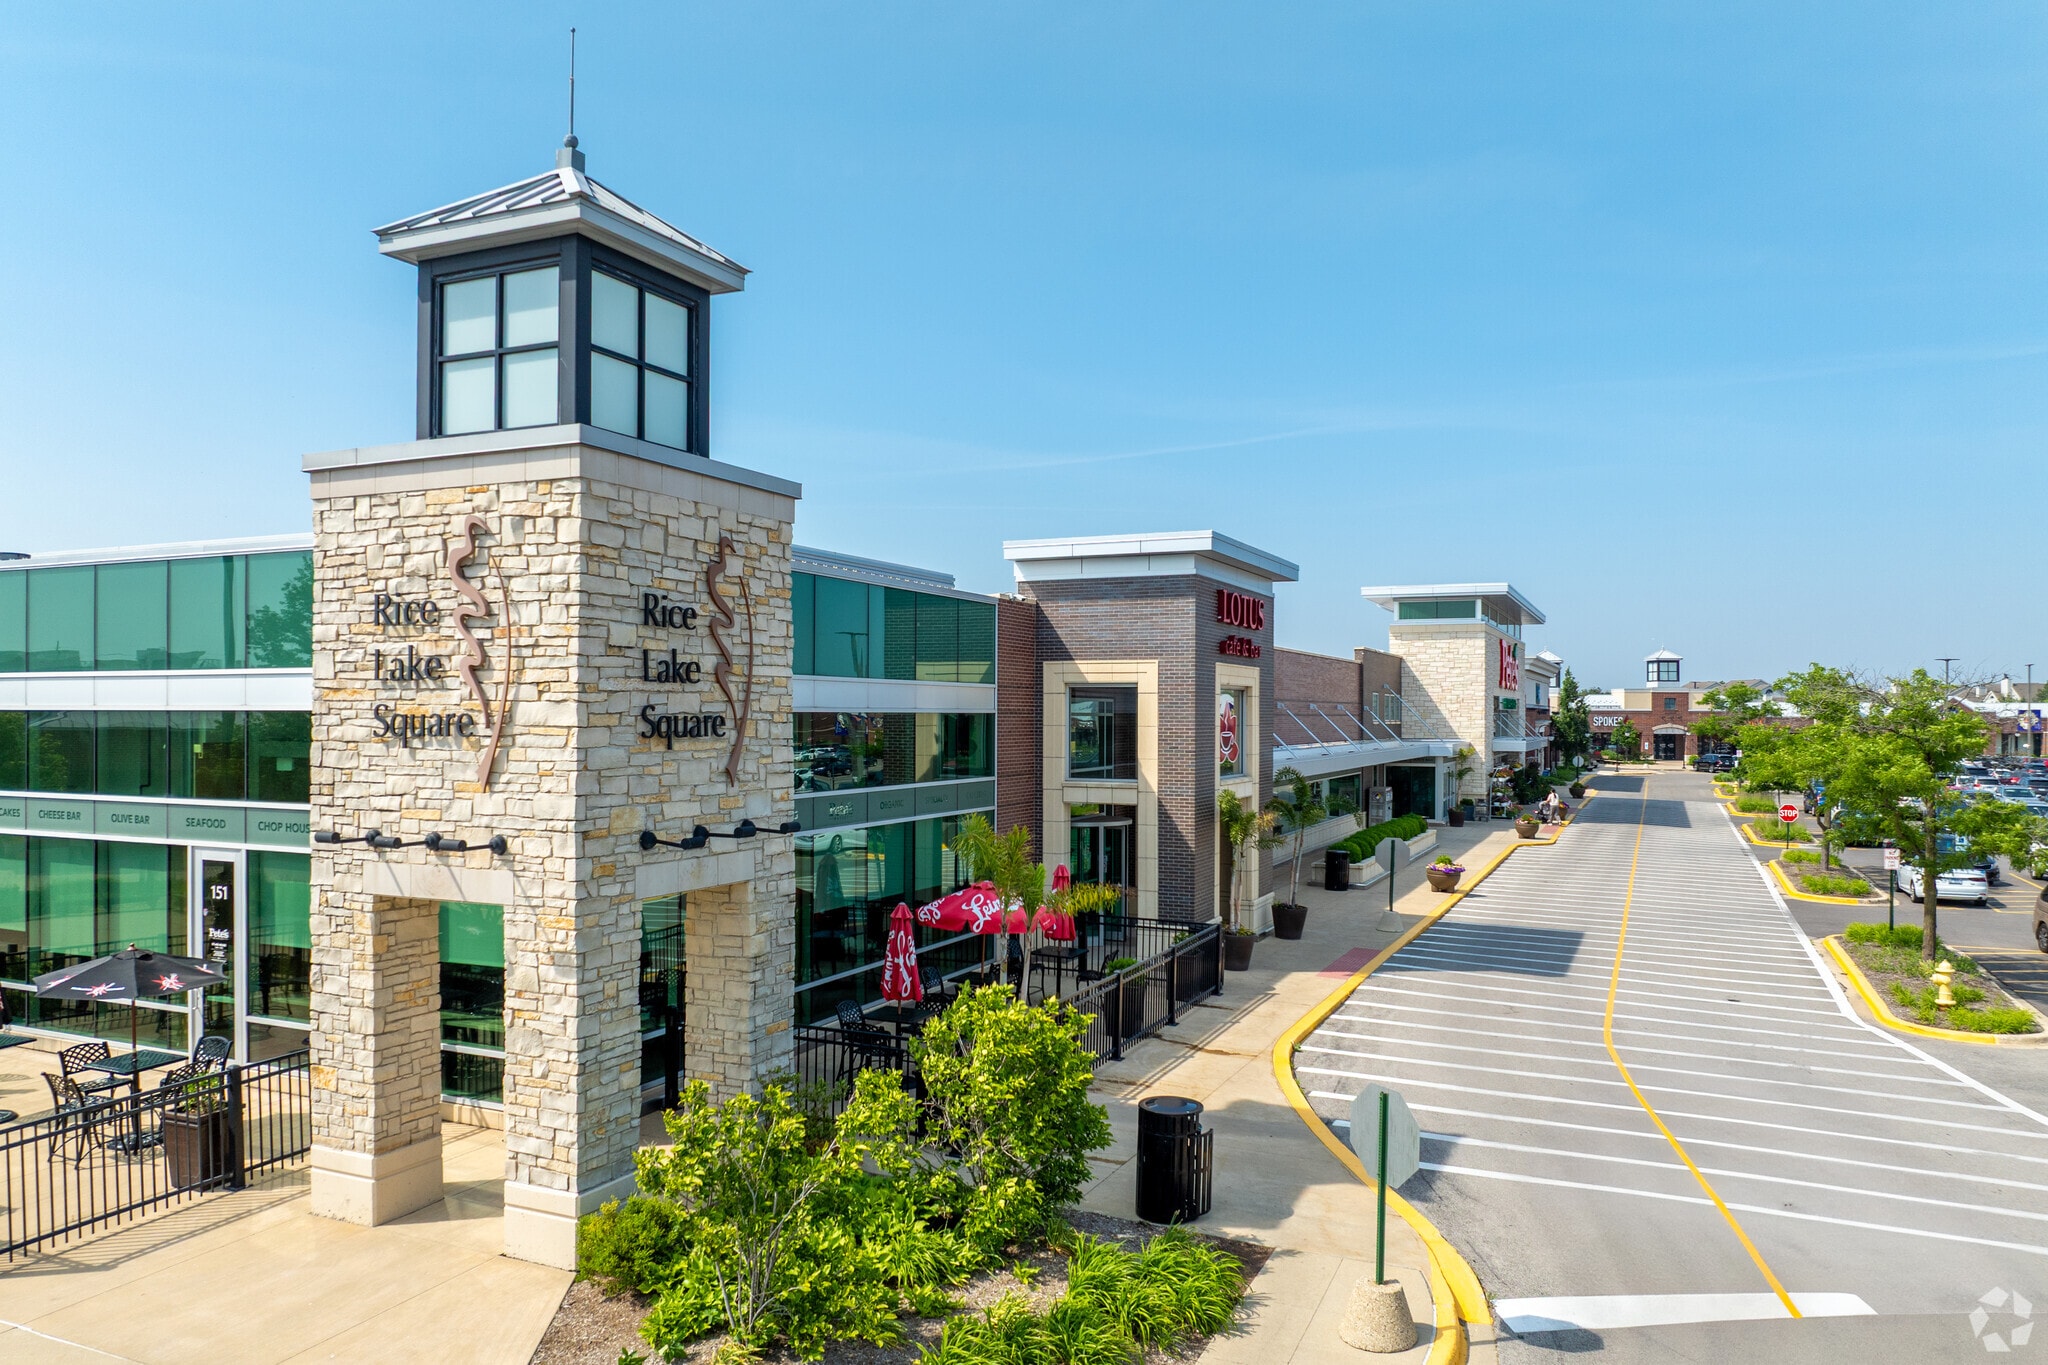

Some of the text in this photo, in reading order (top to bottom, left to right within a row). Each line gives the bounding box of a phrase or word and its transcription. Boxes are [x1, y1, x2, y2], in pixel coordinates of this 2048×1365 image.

[373, 592, 439, 627] Rice
[643, 591, 698, 631] Rice
[1220, 589, 1265, 630] LOTUS
[373, 645, 443, 682] Lake
[643, 648, 702, 685] Lake
[372, 703, 475, 749] Square
[640, 704, 727, 750] Square
[38, 809, 82, 821] CHEESE BAR
[110, 813, 150, 825] OLIVE BAR
[185, 817, 227, 829] SEAFOOD
[257, 821, 311, 834] CHOP HOUS
[1779, 809, 1797, 817] STOP
[210, 884, 228, 900] 151
